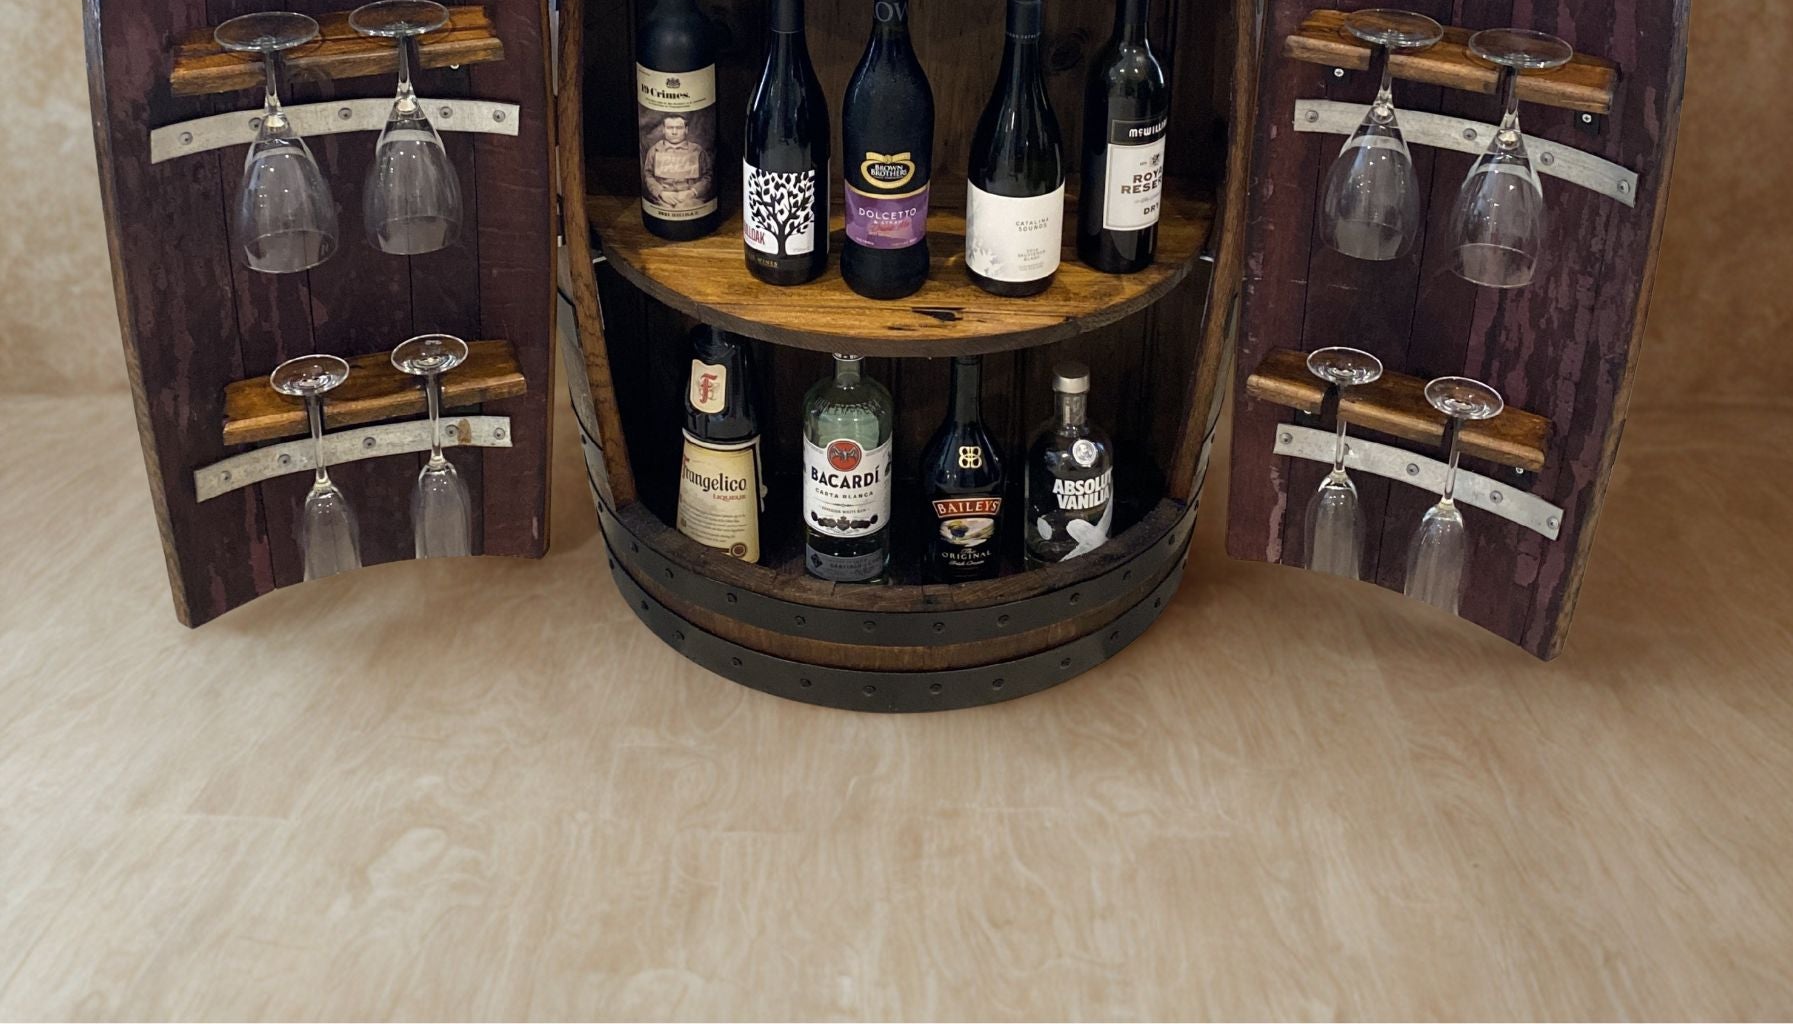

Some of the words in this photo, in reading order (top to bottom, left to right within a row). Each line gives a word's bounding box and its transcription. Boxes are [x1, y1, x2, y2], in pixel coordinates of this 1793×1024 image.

[870, 168, 908, 177] BROTHERS
[874, 163, 904, 171] BROWN
[858, 207, 917, 220] DOLCETTO
[811, 465, 880, 489] BACARDÍ
[1052, 465, 1113, 496] ABSOLUT
[1056, 486, 1110, 510] VANILIA
[936, 500, 999, 515] BAILEYS
[941, 549, 992, 561] ORIGINAL
